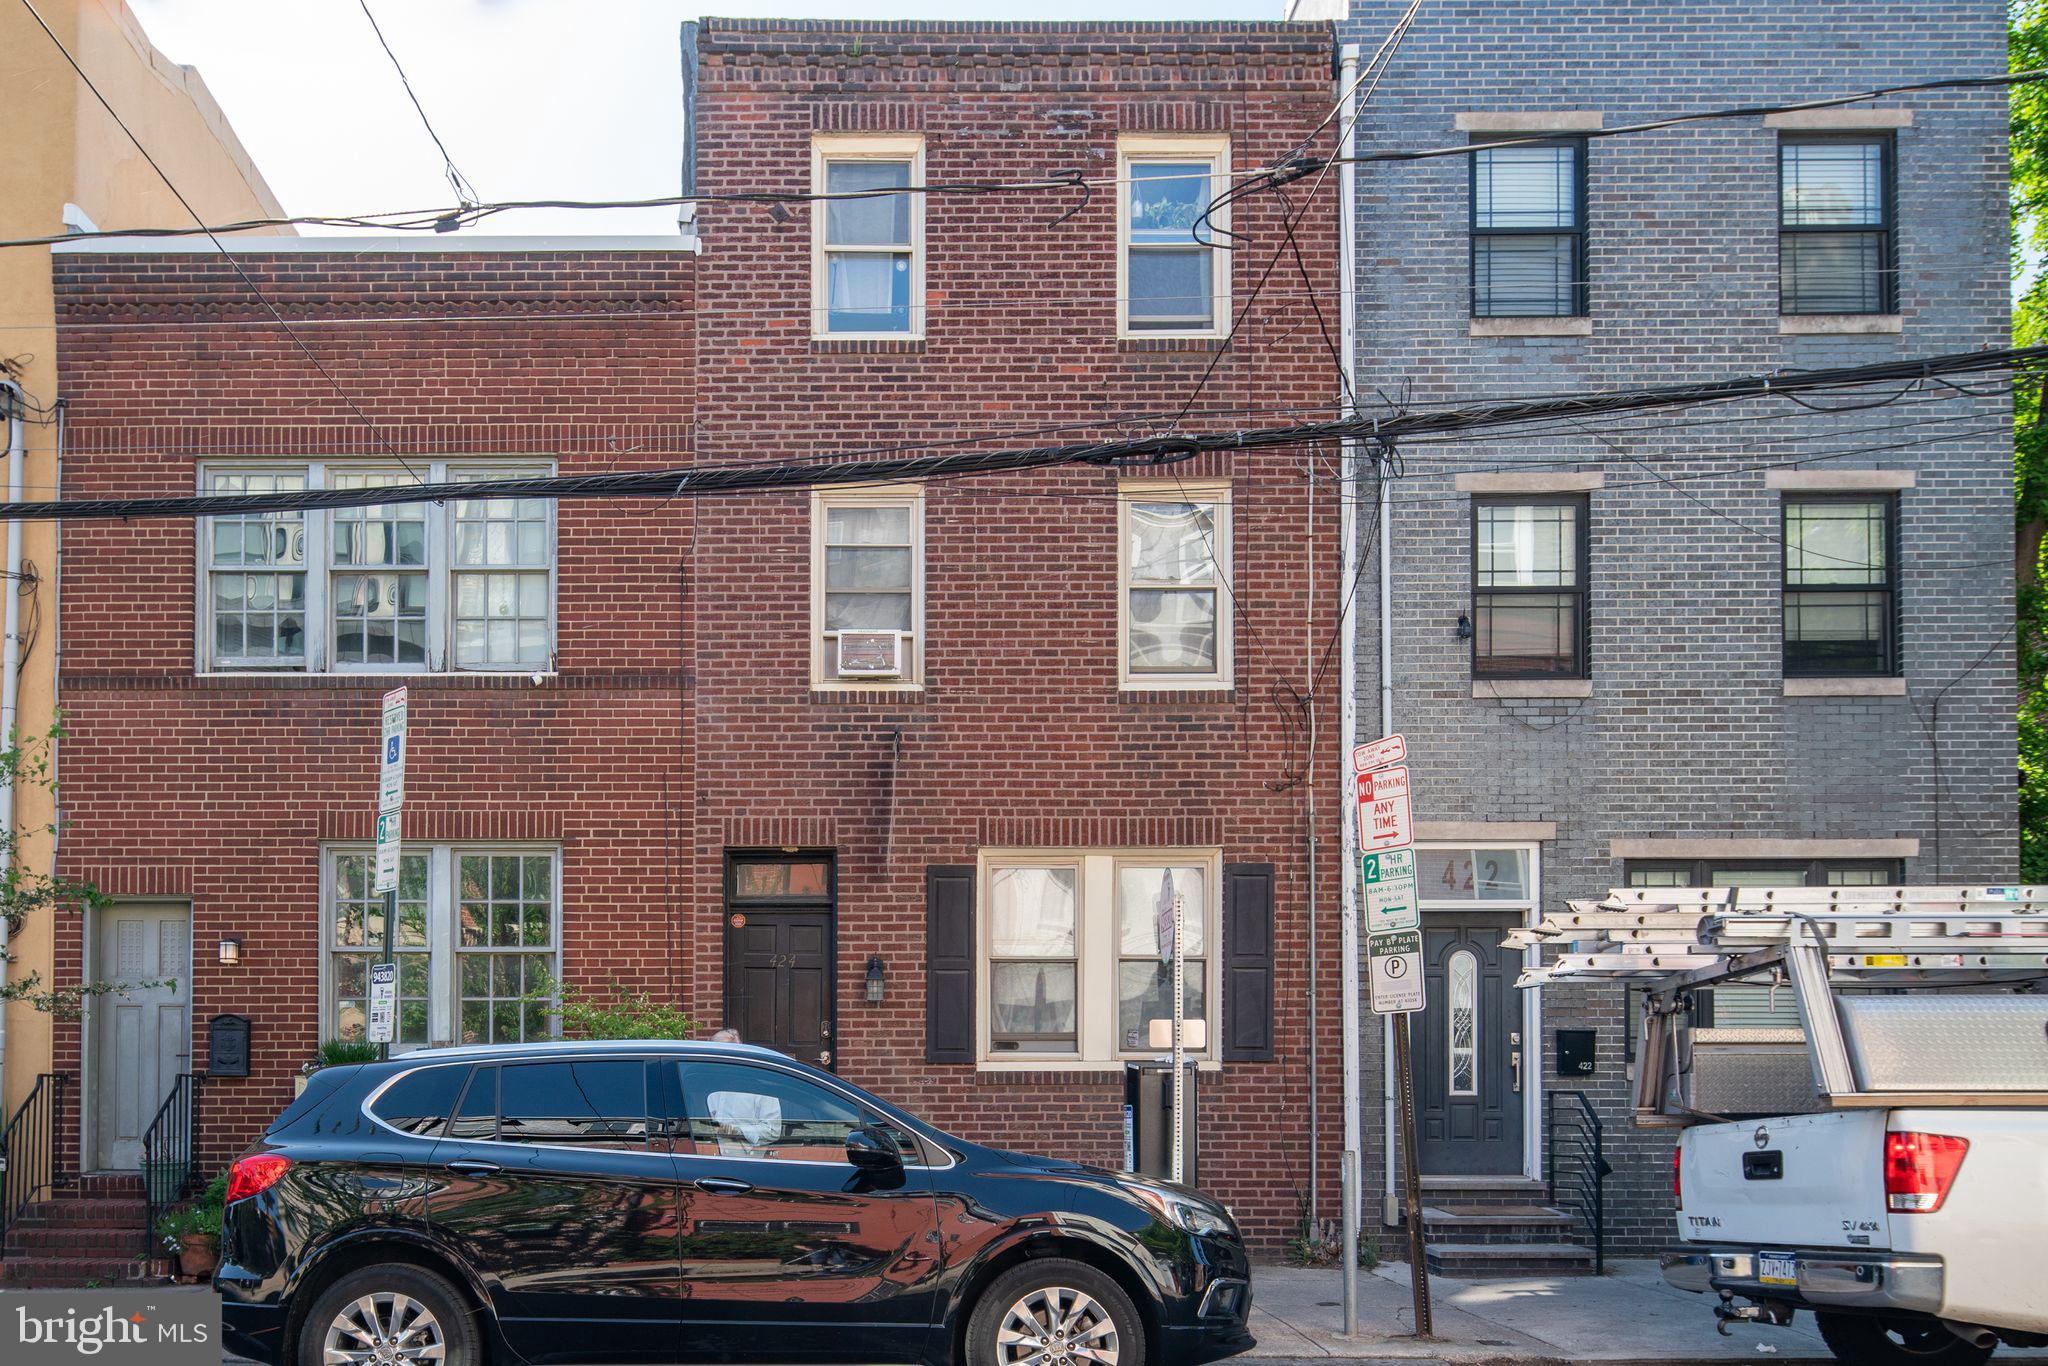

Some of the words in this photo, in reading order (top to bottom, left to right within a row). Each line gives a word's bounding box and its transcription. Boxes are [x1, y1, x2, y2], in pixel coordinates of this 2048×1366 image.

[1359, 781, 1372, 797] NO
[1374, 776, 1406, 791] PARKING
[1374, 800, 1395, 815] ANY
[1373, 815, 1398, 830] TIME
[380, 820, 385, 840] 2
[1366, 859, 1377, 879] 2
[1390, 854, 1403, 864] HR
[1380, 864, 1413, 879] PARKING
[1442, 859, 1498, 890] 422
[1370, 939, 1384, 947] PAY
[1398, 935, 1419, 944] PLATE
[1380, 945, 1411, 954] PARKING
[770, 954, 796, 968] 424
[373, 971, 394, 982] 943820
[1578, 1062, 1592, 1070] 422
[1688, 1216, 1721, 1227] TITAN
[1842, 1220, 1857, 1230] SV
